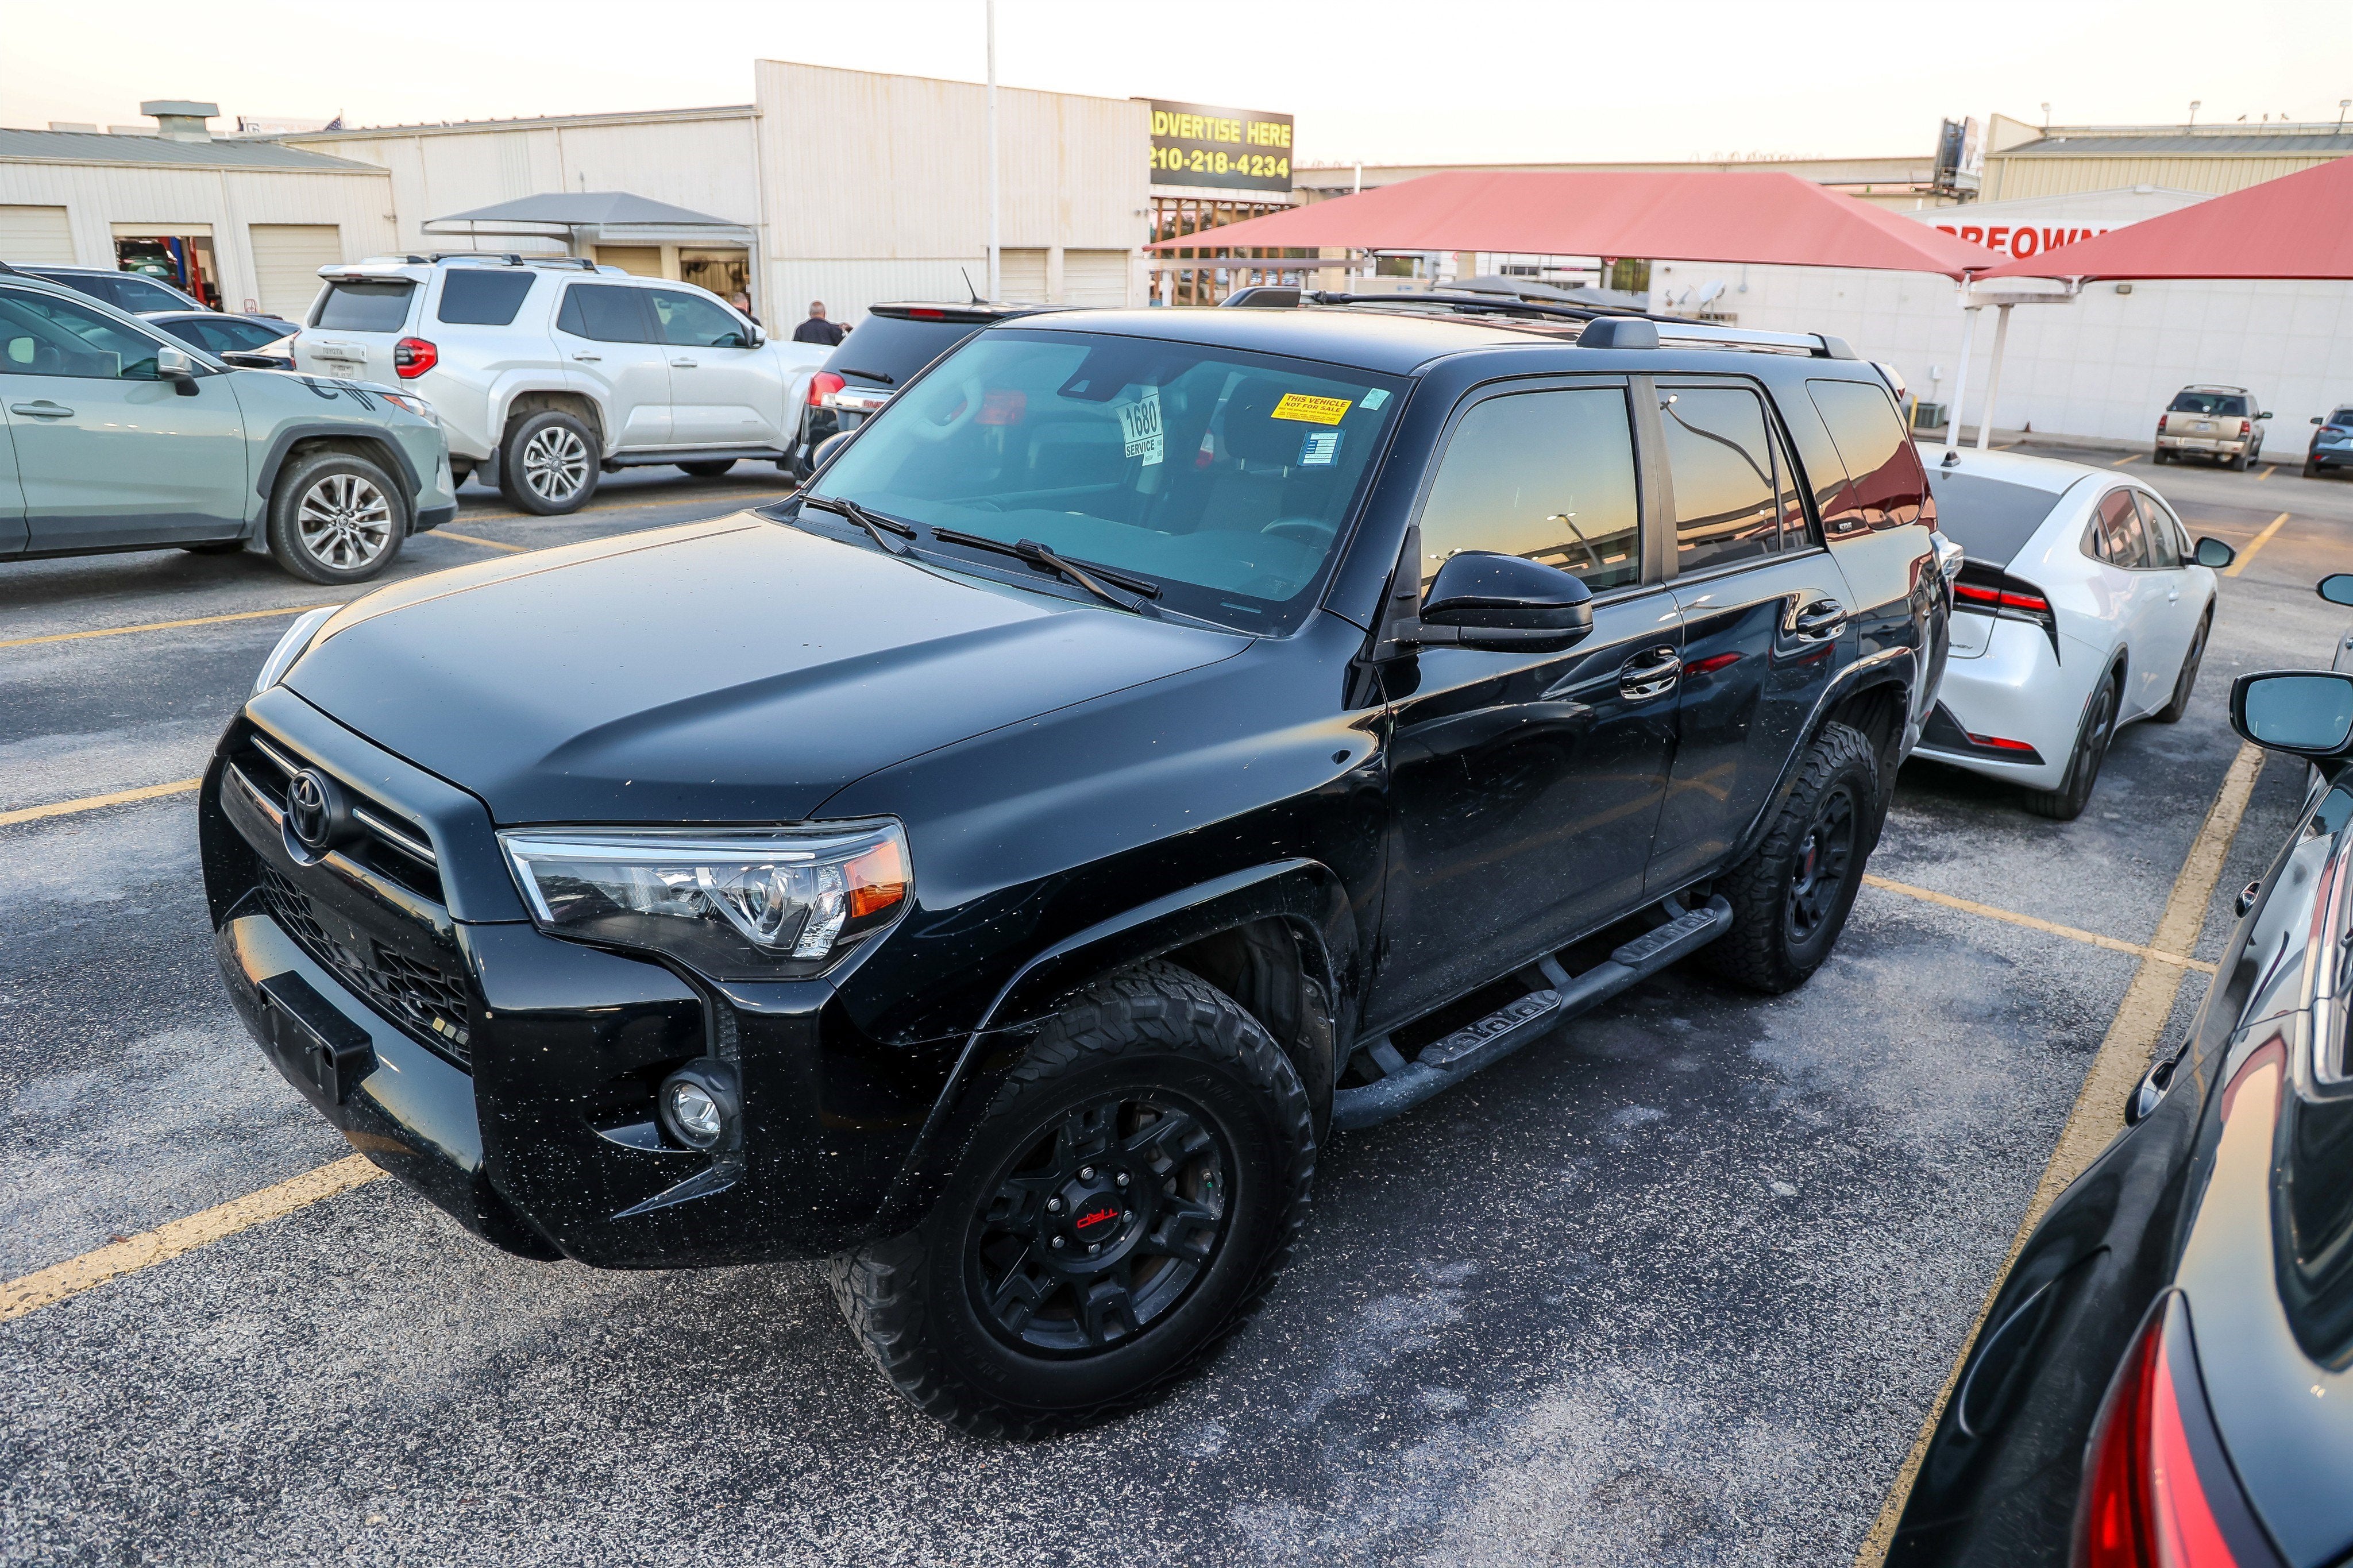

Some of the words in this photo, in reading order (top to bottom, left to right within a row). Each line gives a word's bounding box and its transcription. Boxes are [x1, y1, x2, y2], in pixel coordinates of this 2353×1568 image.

[1247, 121, 1291, 149] HERE
[1150, 145, 1289, 179] 210-218-4234
[1309, 398, 1348, 408] VEHICLE
[1126, 400, 1157, 438] 1680
[1127, 439, 1154, 457] SERVICE
[1077, 1208, 1118, 1229] TRD
